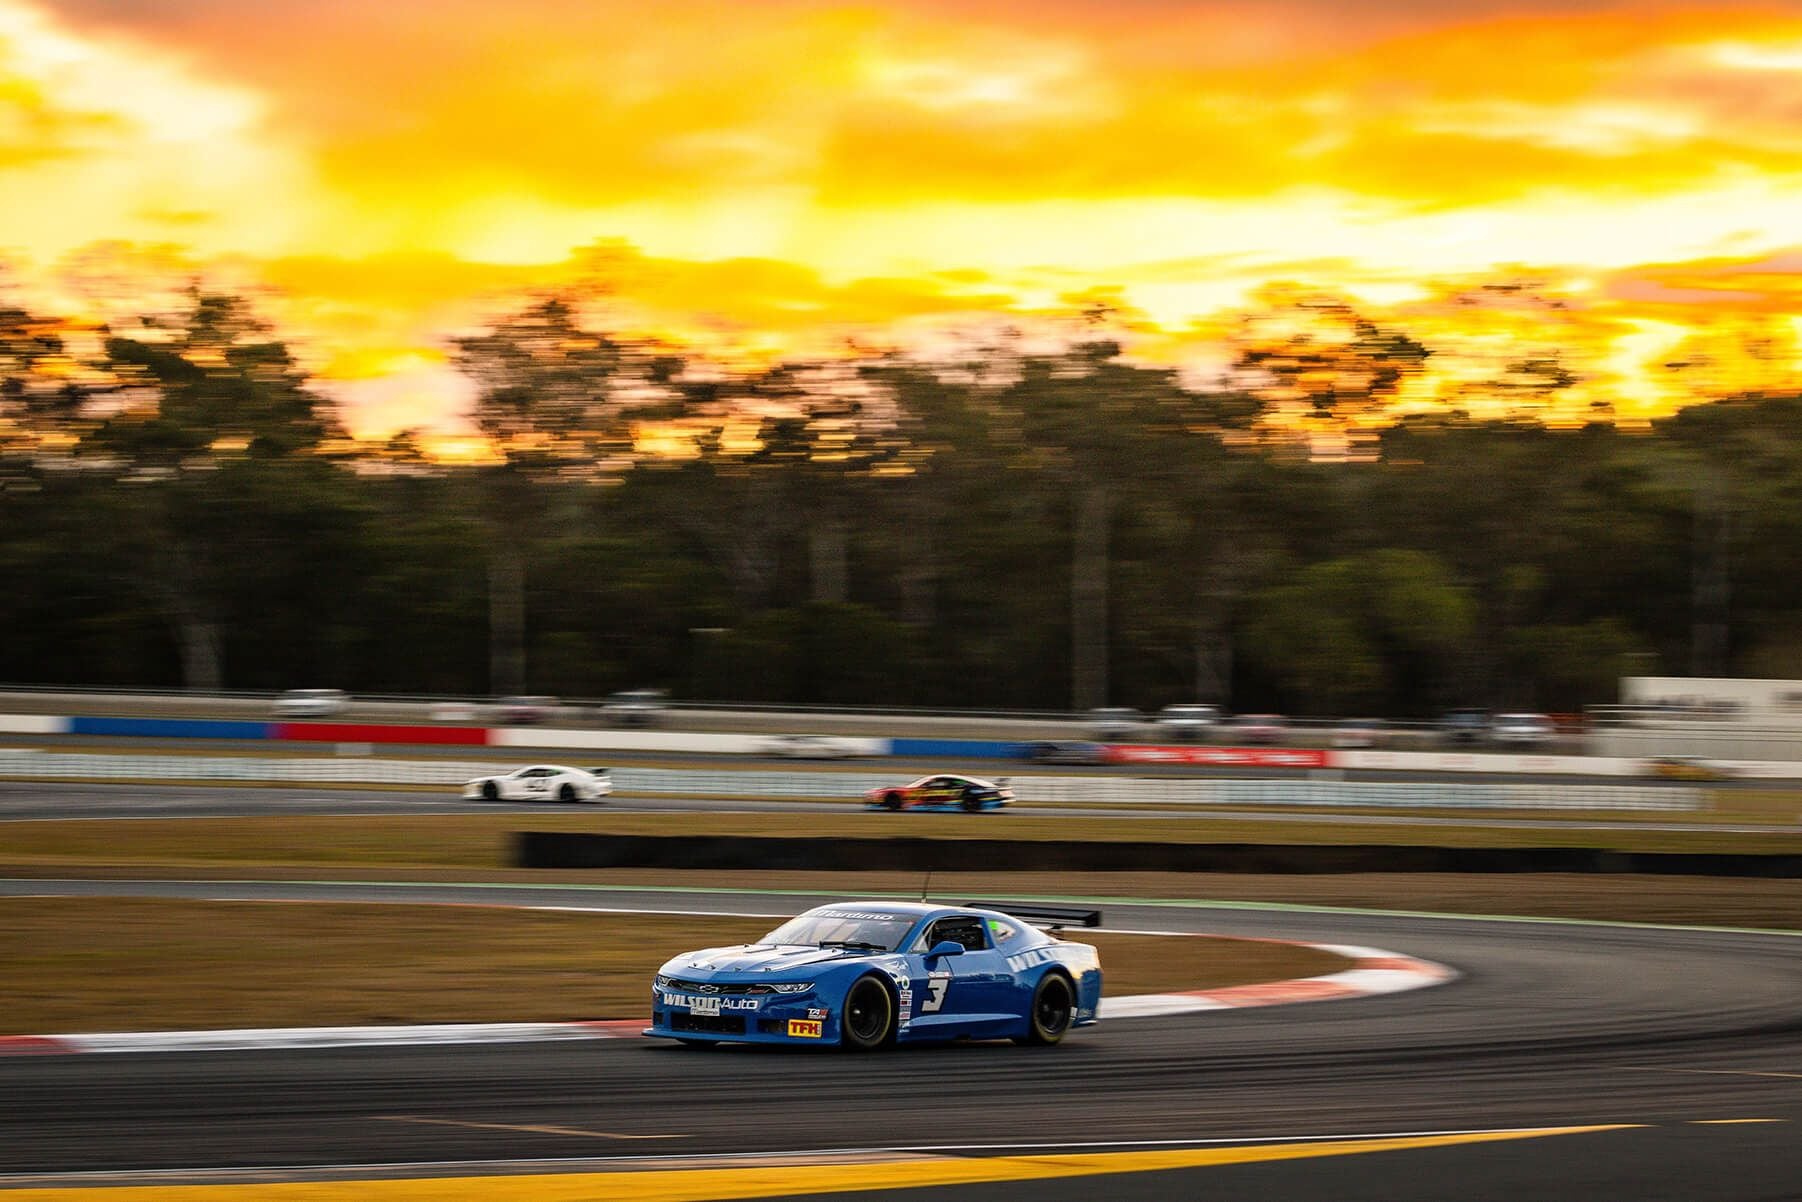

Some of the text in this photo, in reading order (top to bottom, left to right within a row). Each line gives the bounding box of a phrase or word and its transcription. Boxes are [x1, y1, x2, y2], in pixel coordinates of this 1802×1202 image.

[663, 993, 759, 1010] WILSON Auto
[921, 979, 949, 1012] 3
[790, 1021, 818, 1035] TFH
